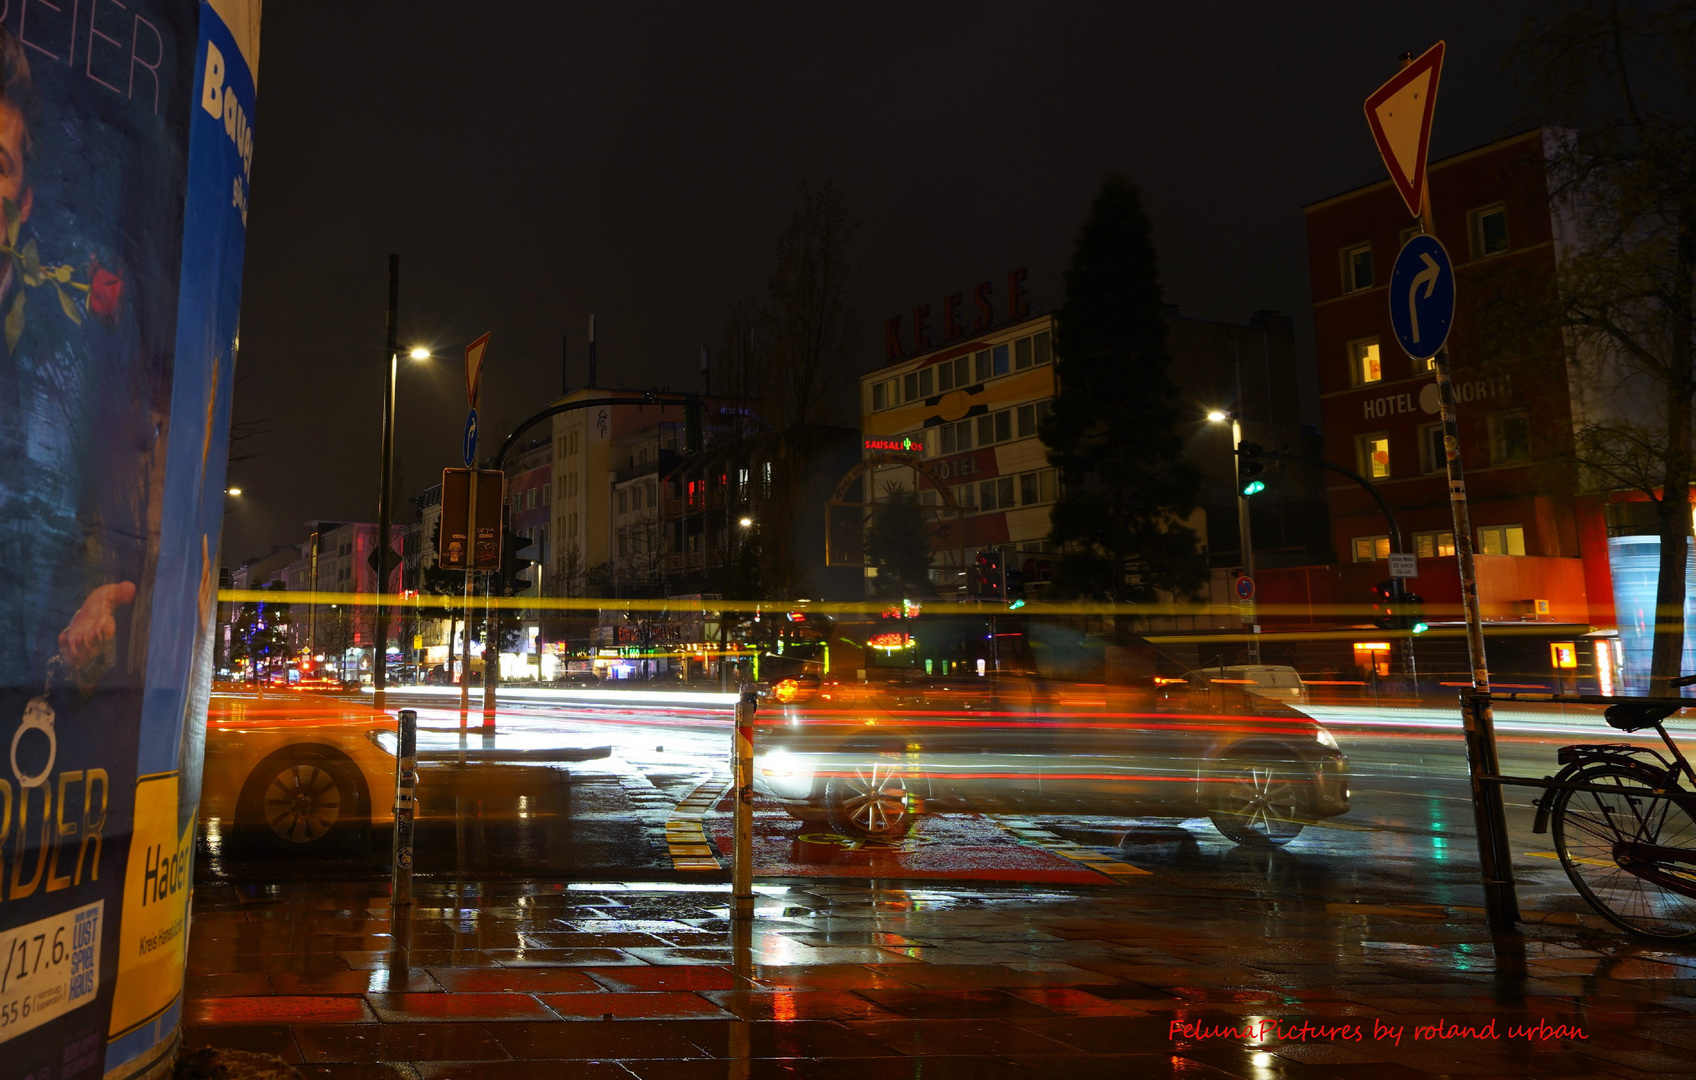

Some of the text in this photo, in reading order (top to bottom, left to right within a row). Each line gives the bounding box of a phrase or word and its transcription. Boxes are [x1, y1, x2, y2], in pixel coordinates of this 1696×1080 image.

[0, 0, 163, 115] EIER
[885, 267, 1031, 362] KEESE
[1363, 393, 1416, 420] HOTEL
[73, 917, 98, 950] LUST
